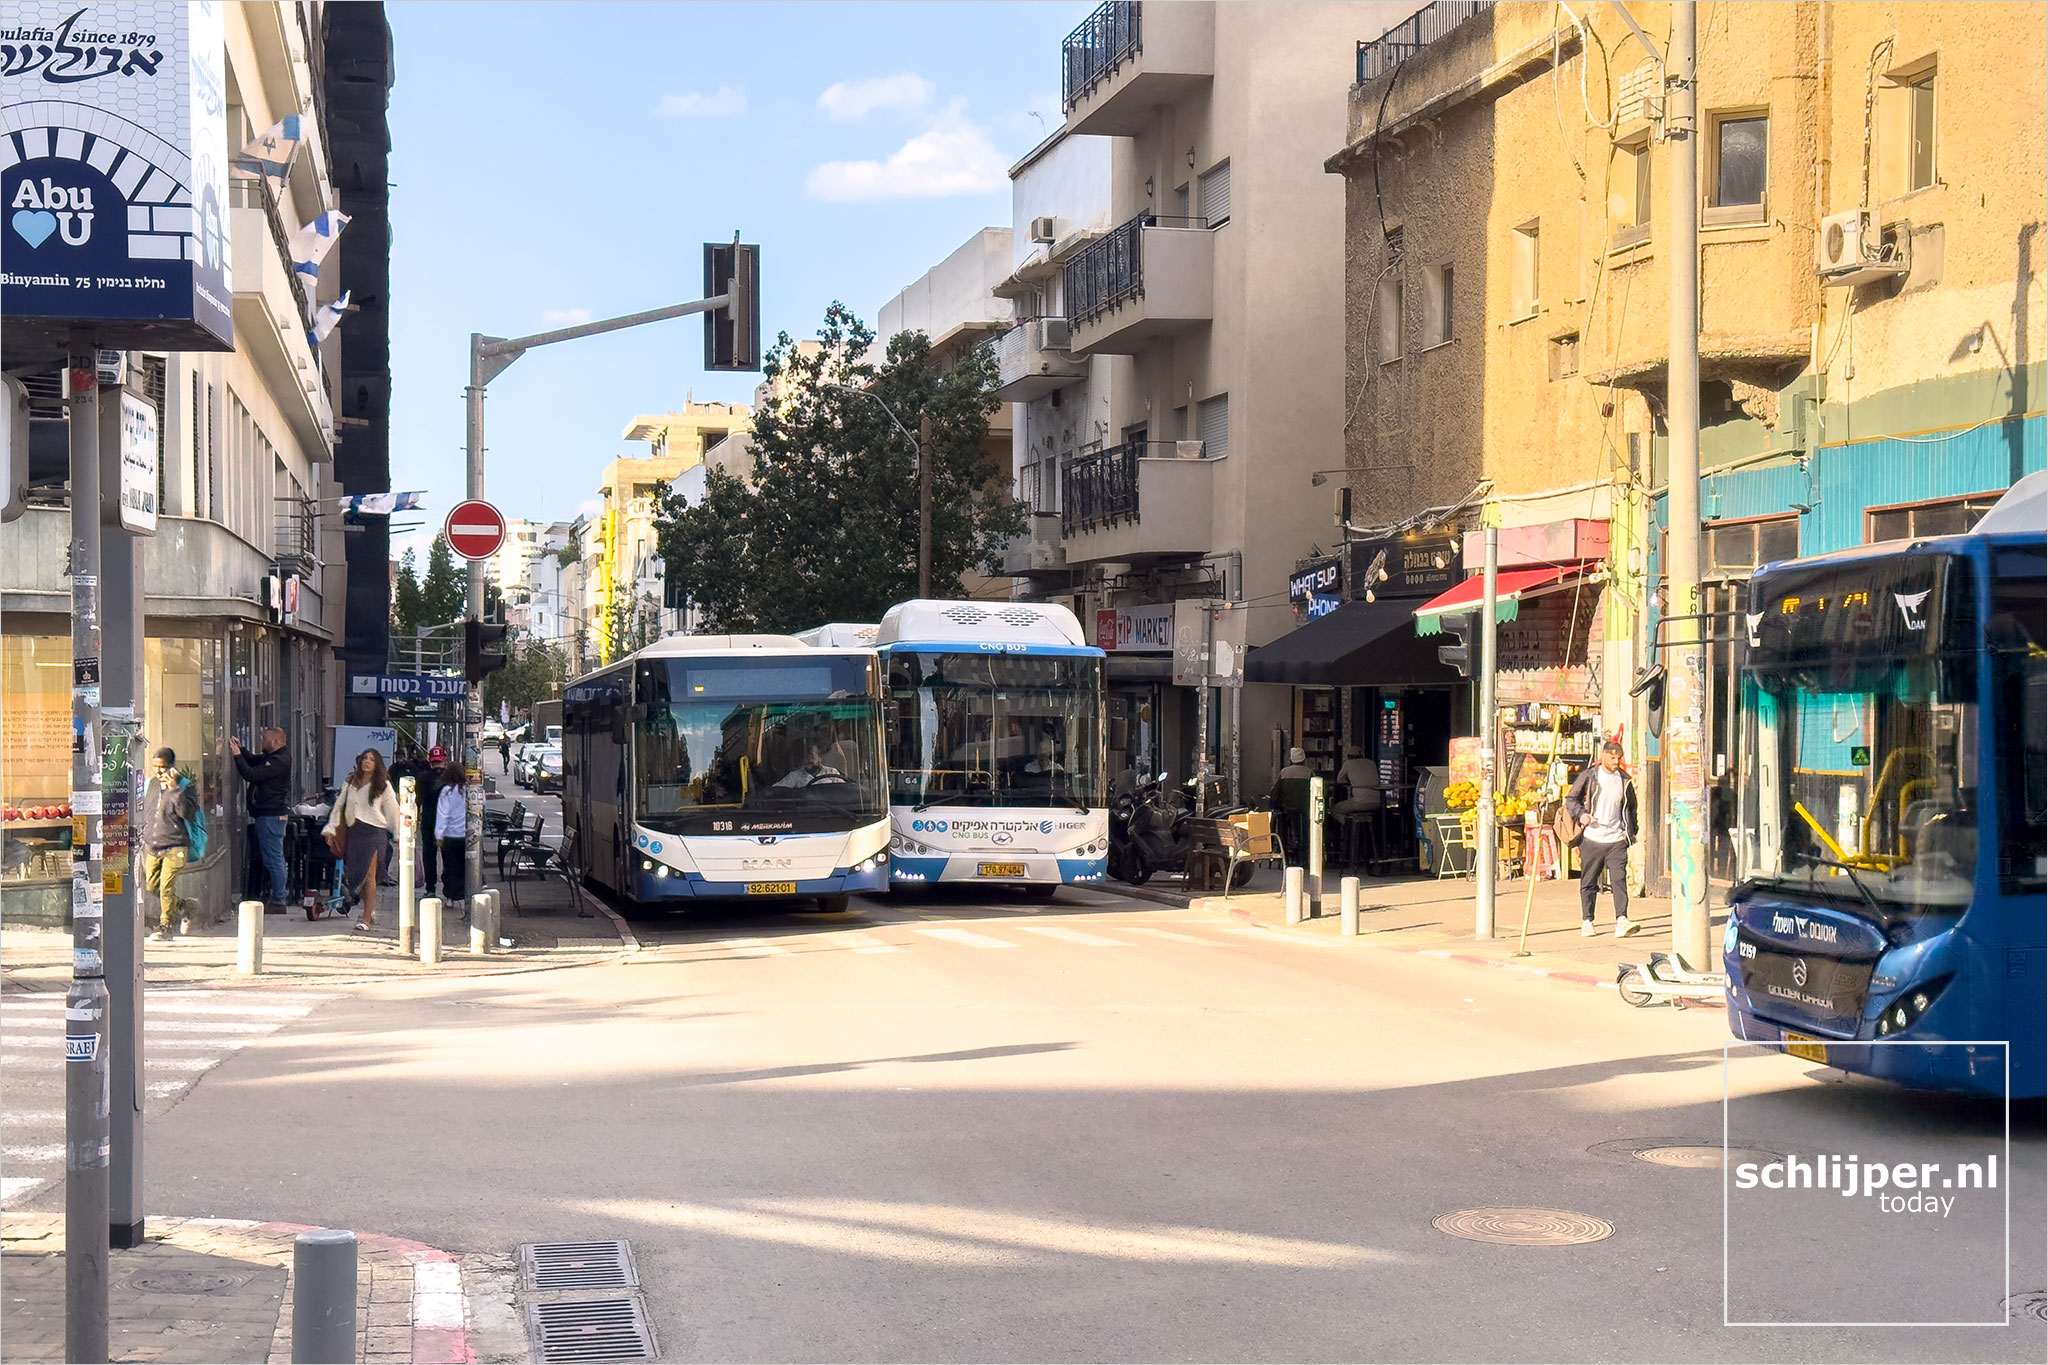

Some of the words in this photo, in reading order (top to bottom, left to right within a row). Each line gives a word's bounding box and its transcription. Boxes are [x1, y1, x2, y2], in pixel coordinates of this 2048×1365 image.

[71, 29, 117, 44] since
[119, 32, 156, 47] 1879
[11, 177, 94, 211] Abu
[56, 212, 94, 246] U
[0, 272, 70, 290] Binyamin
[75, 277, 91, 289] 75
[96, 276, 132, 289] בנימין
[134, 276, 165, 289] נחלת
[75, 396, 93, 404] 234
[1135, 615, 1169, 645] MARKET
[1911, 620, 1926, 630] DAN
[980, 642, 1004, 651] CNG
[1006, 643, 1027, 652] BUS
[380, 678, 420, 694] בטוח
[751, 821, 793, 830] MERKAVIM
[951, 821, 989, 833] אפיקים
[990, 821, 1039, 833] אלקטרה
[743, 858, 792, 870] MAN
[1809, 921, 1837, 944] אוטובוס
[1739, 942, 1757, 960] 12159
[1768, 984, 1801, 1001] GOLDEN
